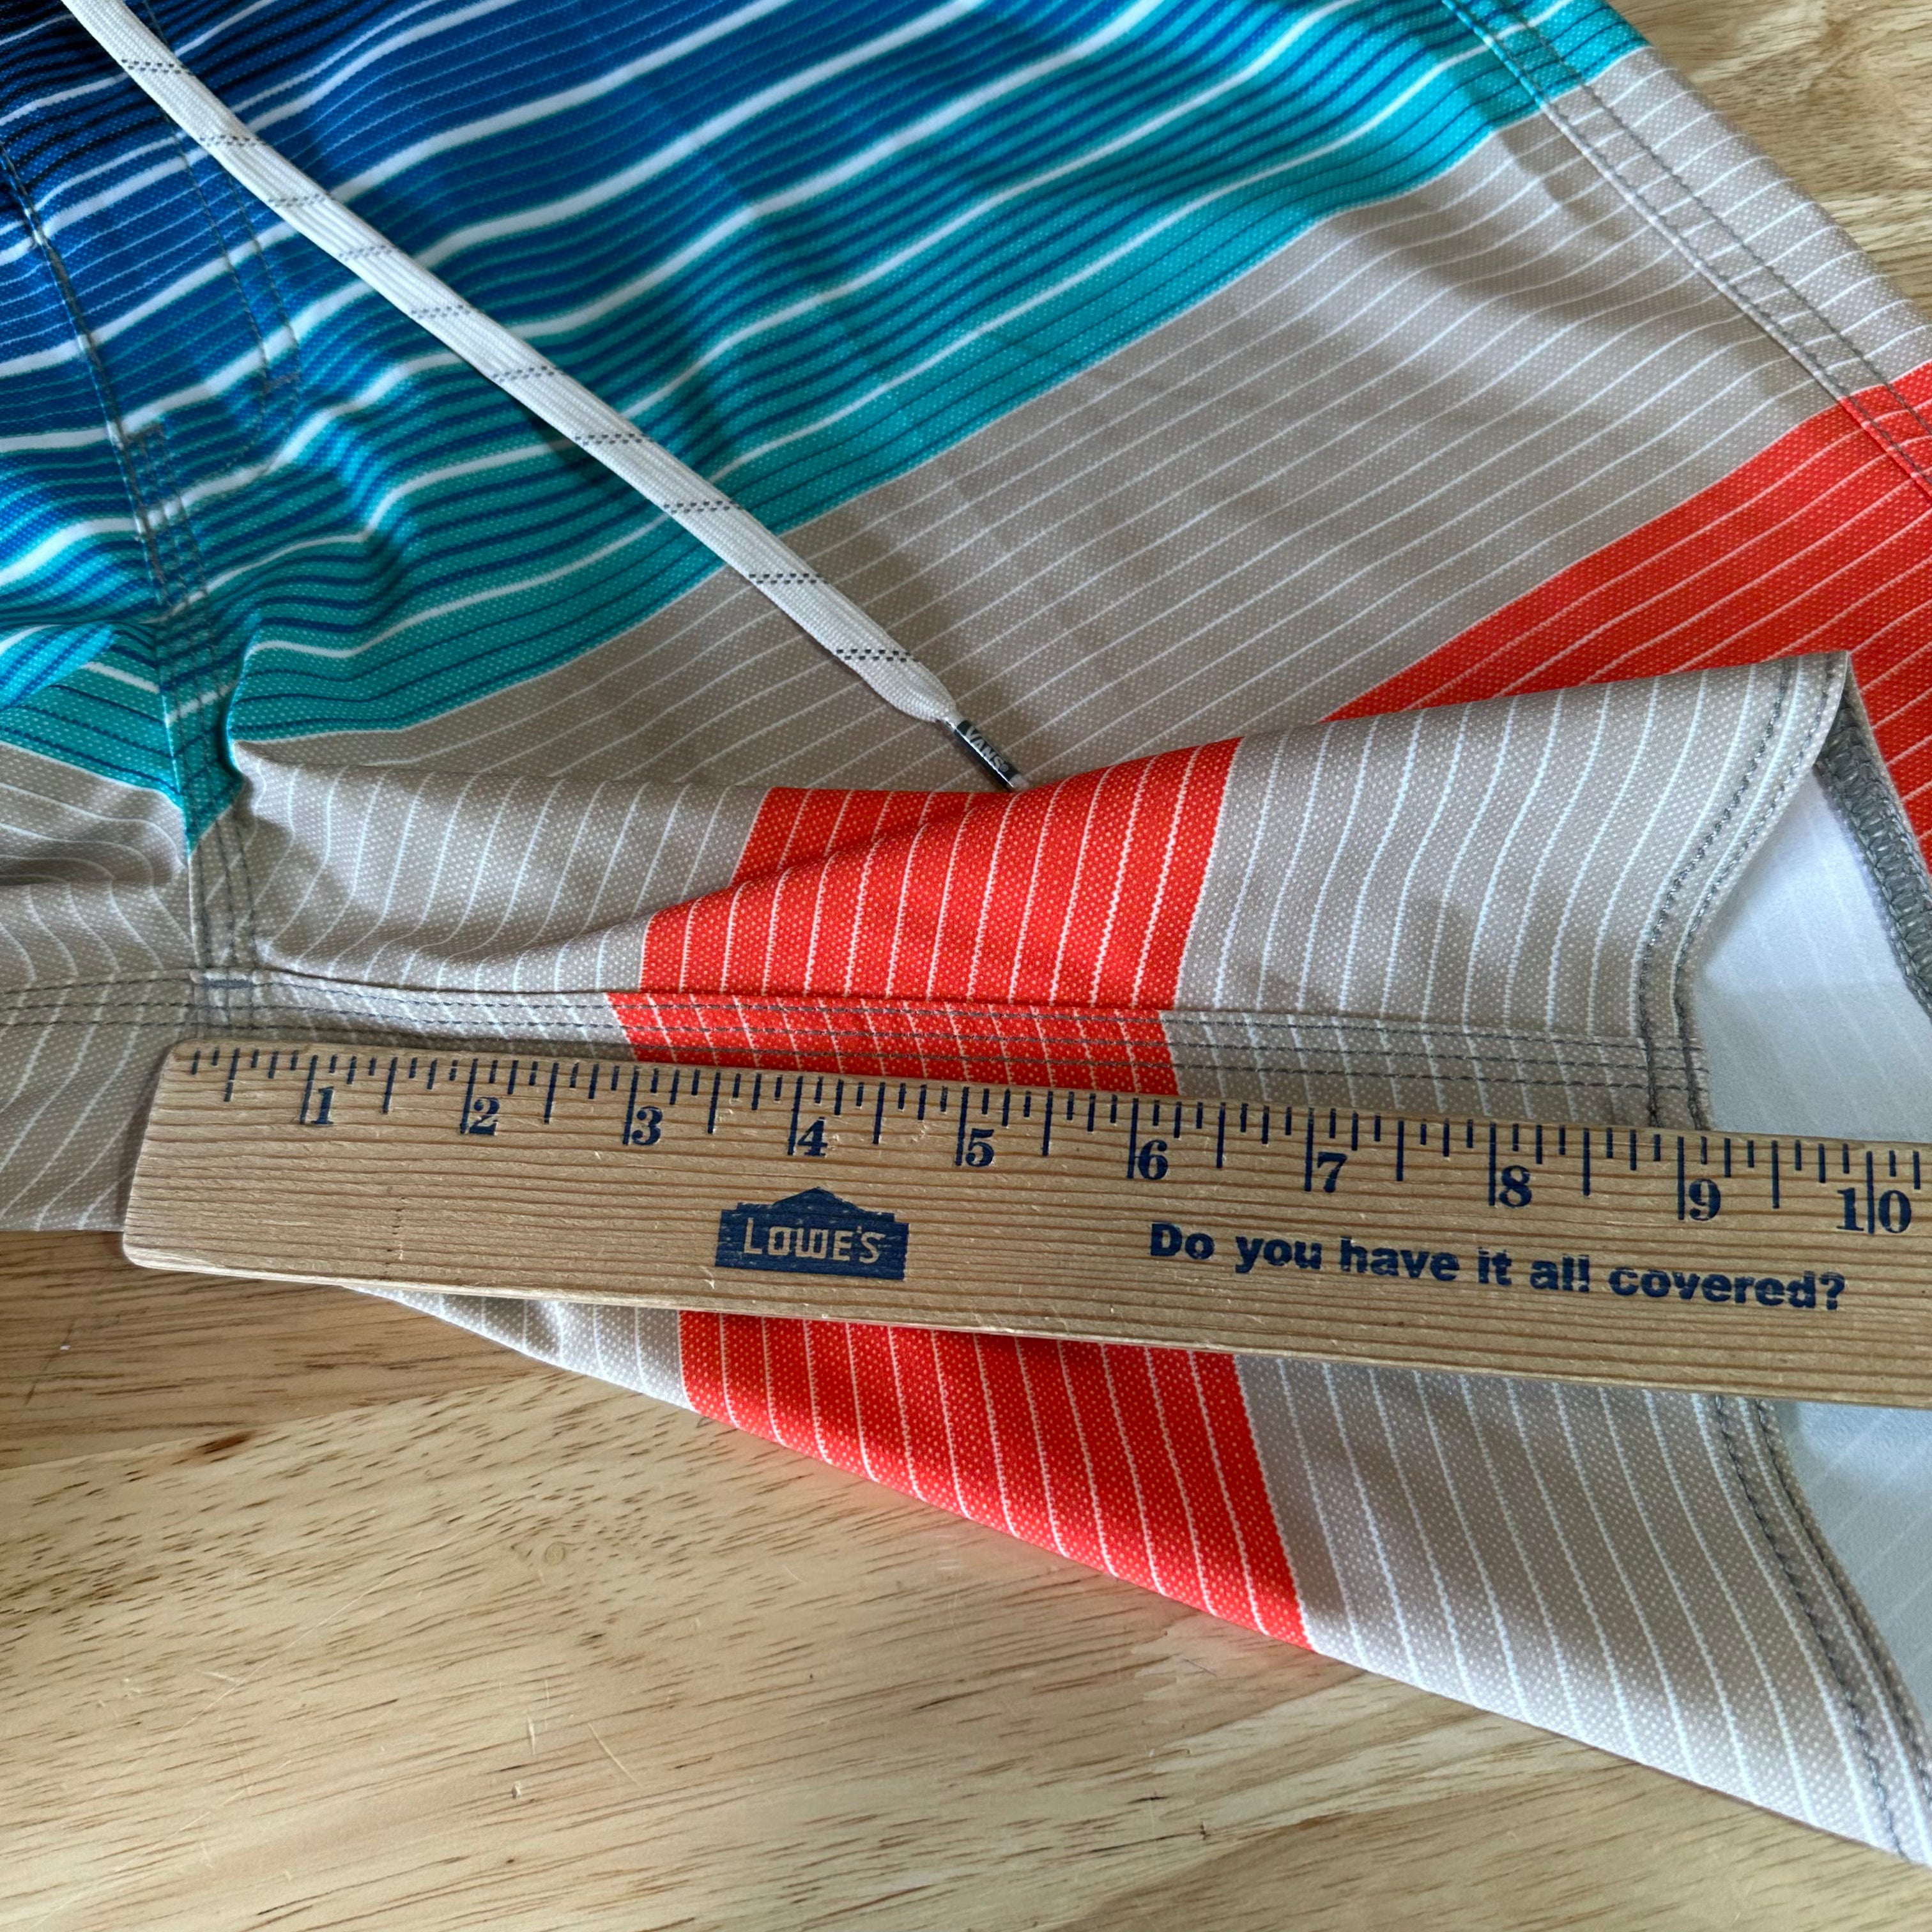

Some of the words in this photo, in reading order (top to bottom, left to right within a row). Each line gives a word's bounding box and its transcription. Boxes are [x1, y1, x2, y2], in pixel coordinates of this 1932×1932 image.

[965, 725, 1005, 770] VANS
[311, 1085, 334, 1125] 1
[469, 1096, 501, 1135] 2
[631, 1106, 663, 1146] 3
[798, 1117, 827, 1157] 4
[965, 1128, 995, 1167] 5
[1137, 1139, 1169, 1180] 6
[1317, 1151, 1347, 1193] 7
[1499, 1165, 1532, 1208] 8
[1688, 1178, 1721, 1221] 9
[1836, 1186, 1912, 1233] 10
[742, 1216, 885, 1264] LOWE'S
[1150, 1222, 1214, 1260] Do
[1235, 1236, 1322, 1274] you
[1341, 1236, 1460, 1282] have
[1478, 1246, 1512, 1286] it
[1529, 1254, 1590, 1292] all
[1609, 1266, 1846, 1310] covered?
